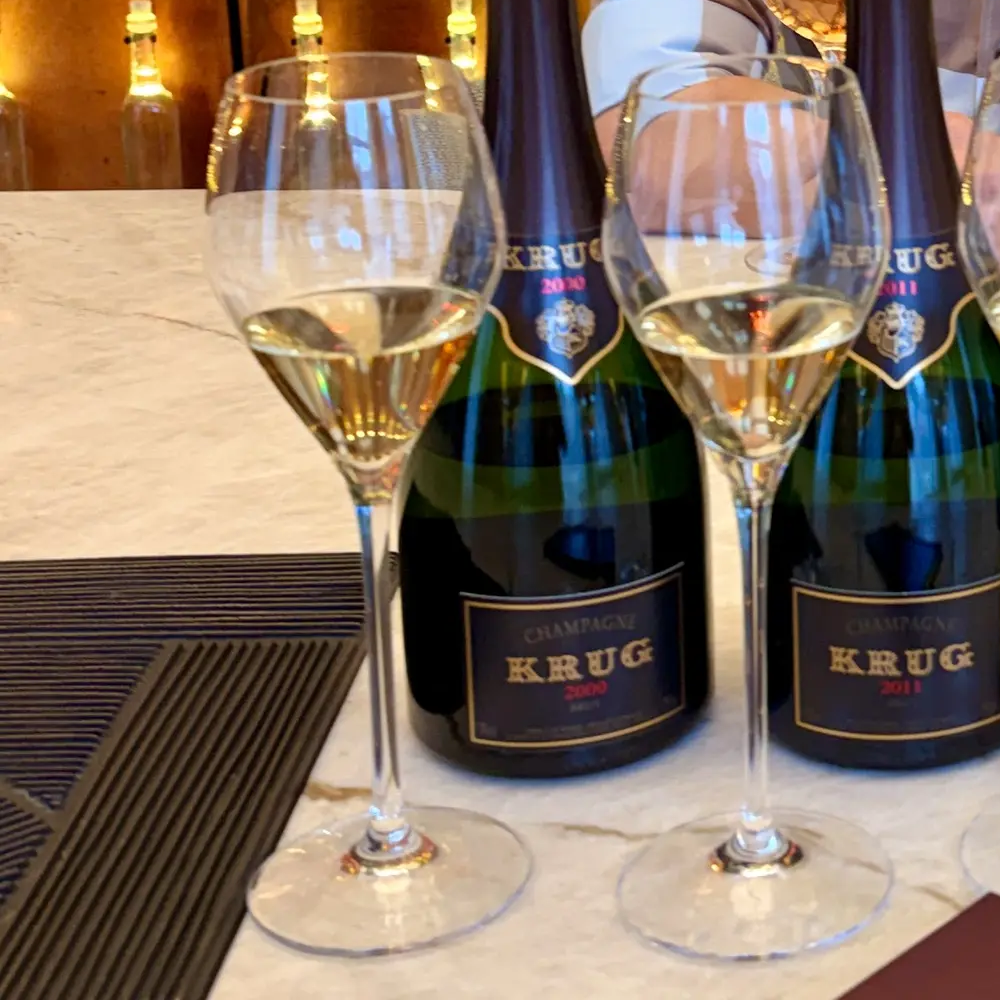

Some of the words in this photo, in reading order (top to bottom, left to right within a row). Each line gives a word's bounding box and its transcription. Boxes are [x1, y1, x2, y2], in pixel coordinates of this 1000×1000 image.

[523, 613, 637, 644] CHAMPAGNE
[504, 637, 654, 683] KRUG
[828, 641, 974, 676] KRUG
[563, 680, 609, 701] 2000
[879, 679, 923, 696] 2011
